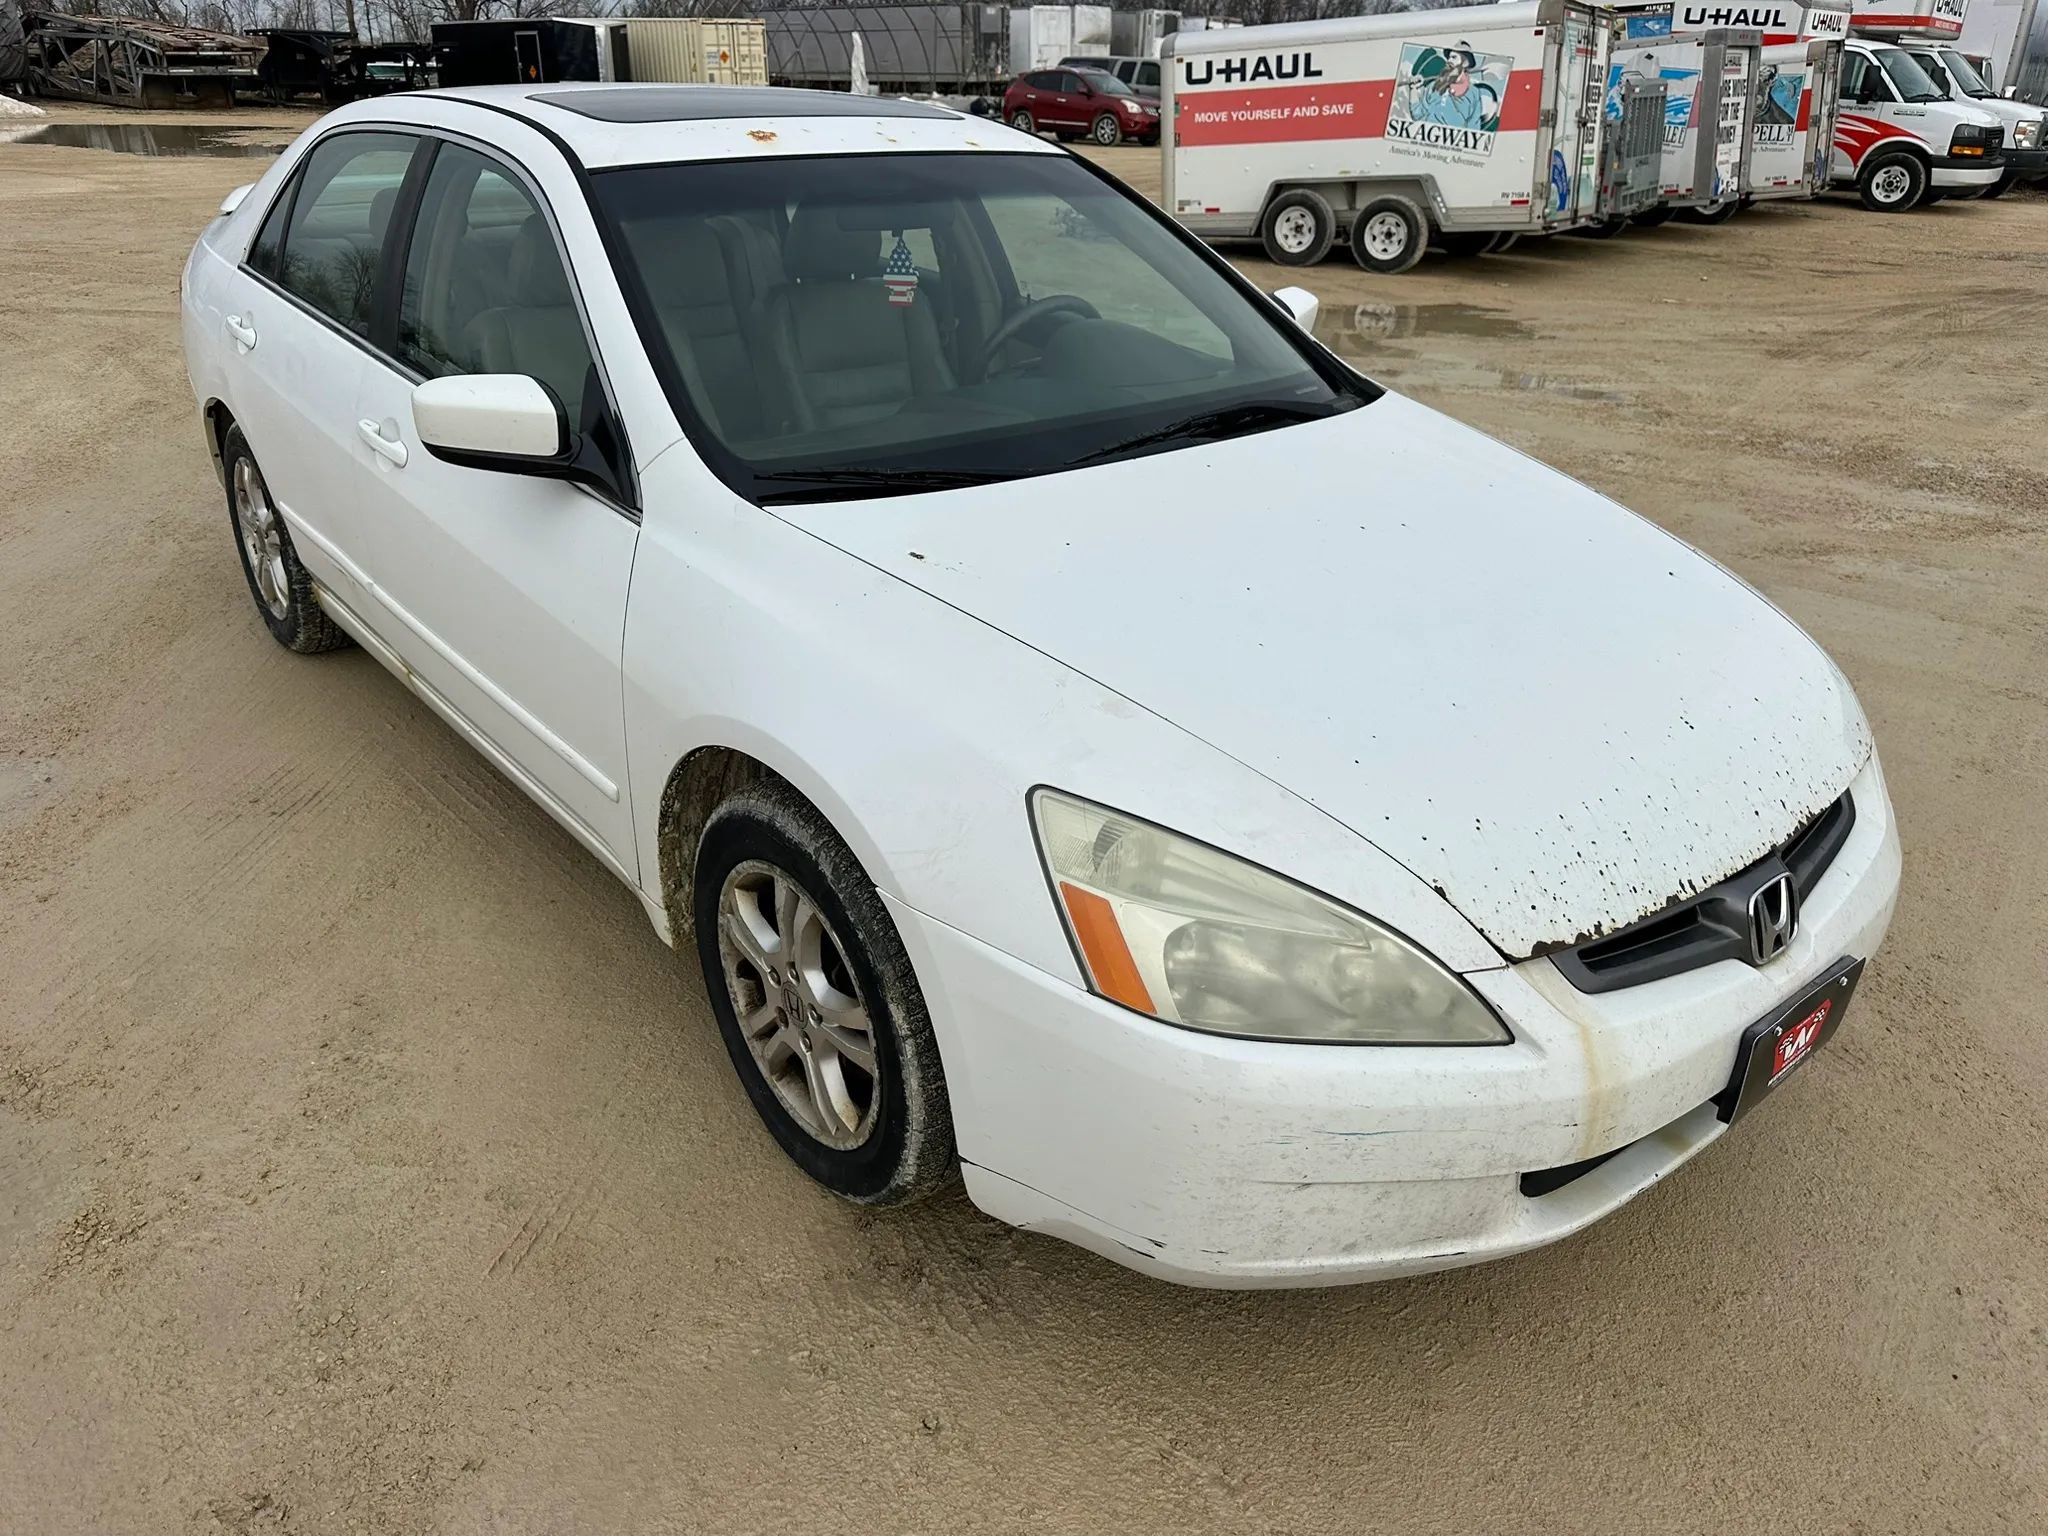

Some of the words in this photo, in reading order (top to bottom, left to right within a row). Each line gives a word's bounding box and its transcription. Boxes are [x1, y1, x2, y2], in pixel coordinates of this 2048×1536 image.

[1684, 8, 1786, 27] U-HAUL
[1811, 12, 1843, 33] U-HAUL
[1185, 52, 1323, 85] U-HAUL
[1194, 111, 1228, 123] MOVE
[1231, 107, 1291, 121] YOURSELF
[1292, 105, 1319, 118] AND
[1322, 103, 1354, 116] SAVE
[1386, 118, 1486, 150] SKAGWAY
[1389, 145, 1421, 157] America's
[1422, 150, 1449, 164] Moving
[1451, 155, 1486, 168] Adventure
